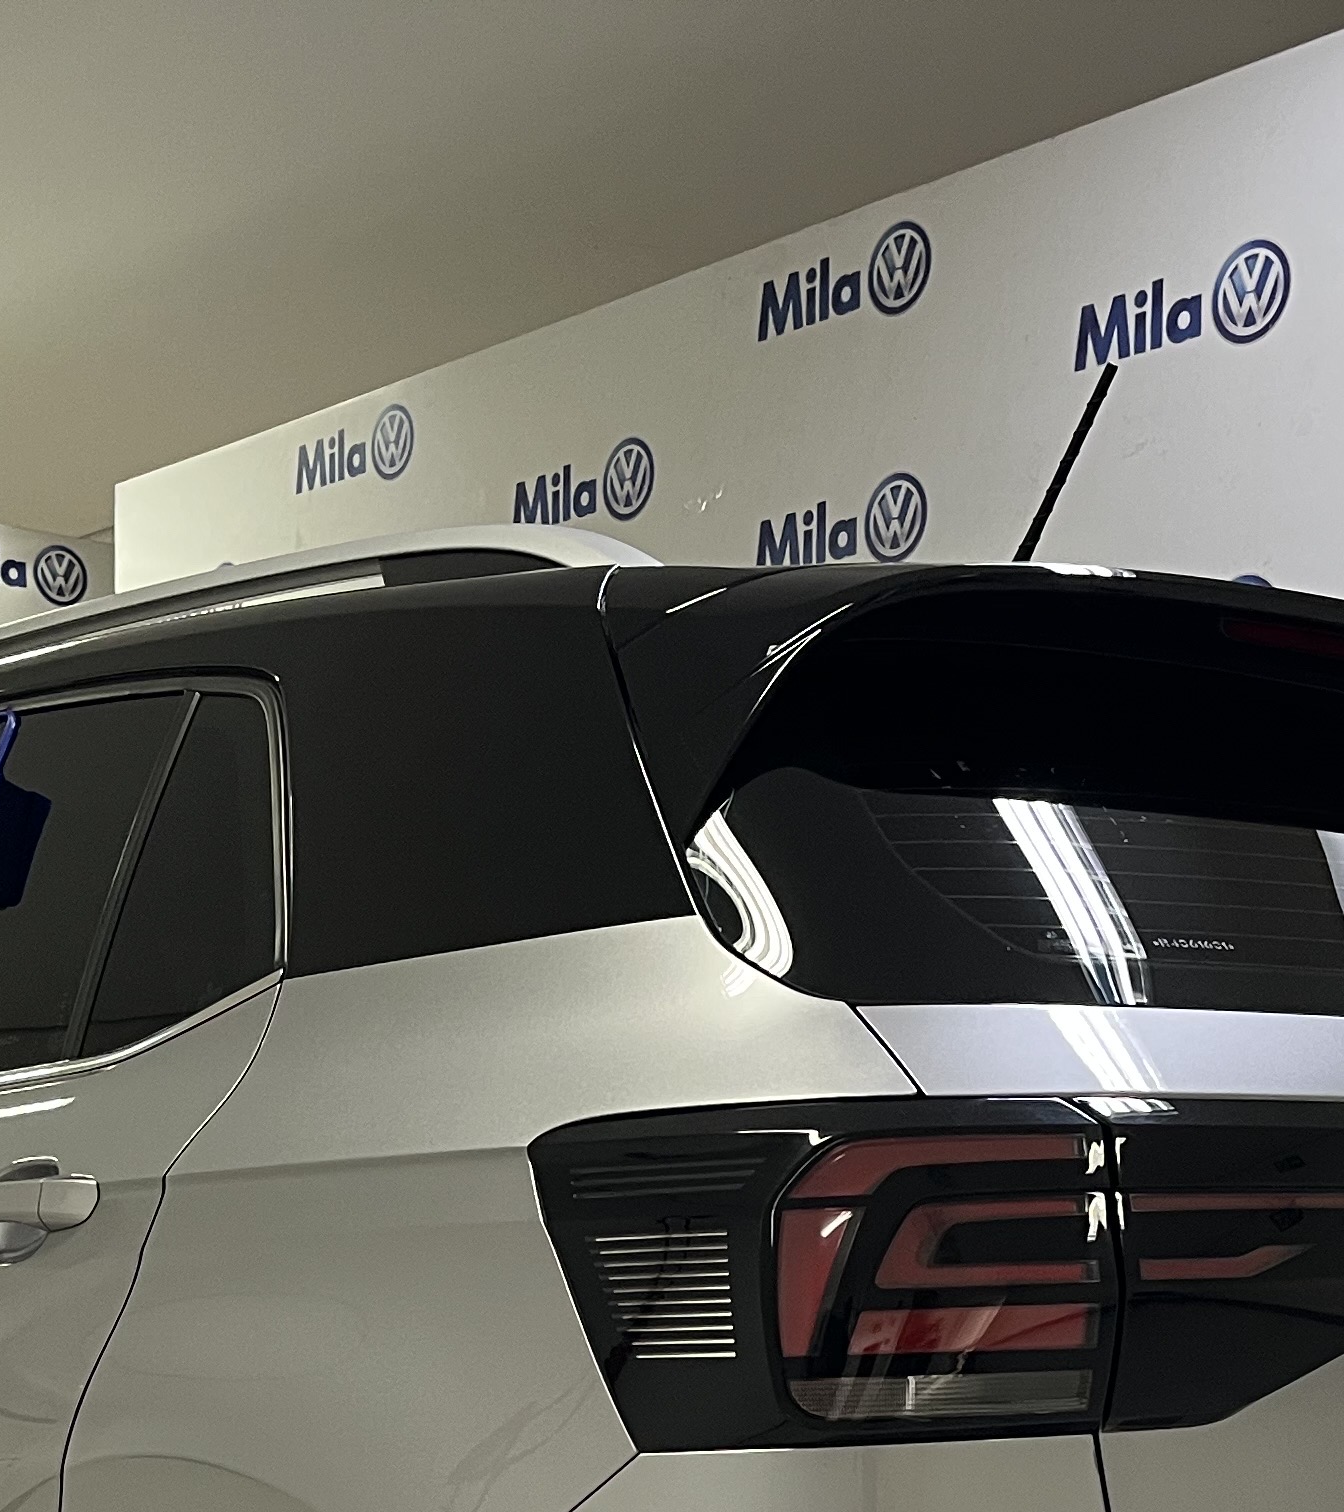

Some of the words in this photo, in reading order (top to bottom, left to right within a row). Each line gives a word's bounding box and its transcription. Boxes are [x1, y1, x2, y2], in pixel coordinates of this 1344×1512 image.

[758, 257, 860, 342] Mila
[1074, 278, 1202, 372] Mila
[296, 429, 366, 494] Mila
[513, 464, 596, 524] Mila
[757, 501, 857, 565] Mila
